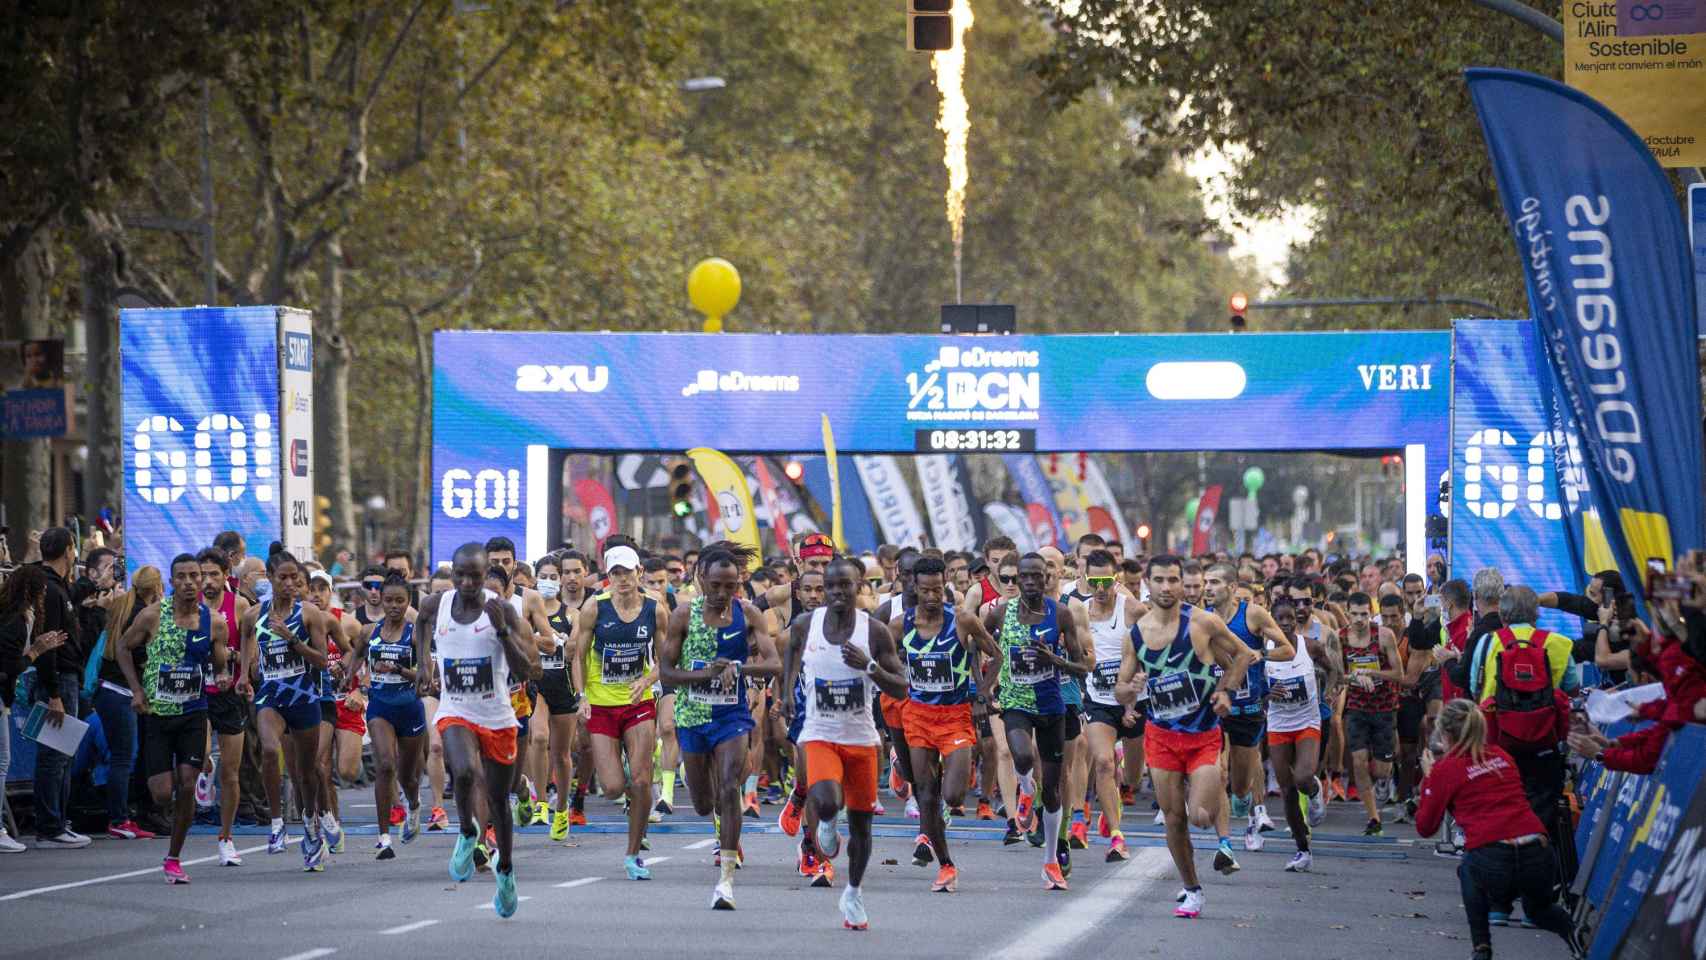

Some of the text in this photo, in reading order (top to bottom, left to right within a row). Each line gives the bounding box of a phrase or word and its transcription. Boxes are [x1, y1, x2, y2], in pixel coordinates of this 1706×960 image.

[1589, 39, 1688, 57] Sostenible
[1575, 61, 1616, 73] Menjant
[1618, 60, 1664, 70] canviem
[1666, 60, 1675, 69] el
[288, 335, 309, 367] START
[961, 347, 1040, 367] eDreams
[515, 364, 609, 392] 2XU
[719, 371, 799, 391] eDreams
[947, 372, 1040, 410] BCN
[1357, 364, 1432, 391] VERI
[931, 430, 1020, 449] 08:31:32
[134, 412, 273, 504] GO!
[441, 468, 520, 519] GO!
